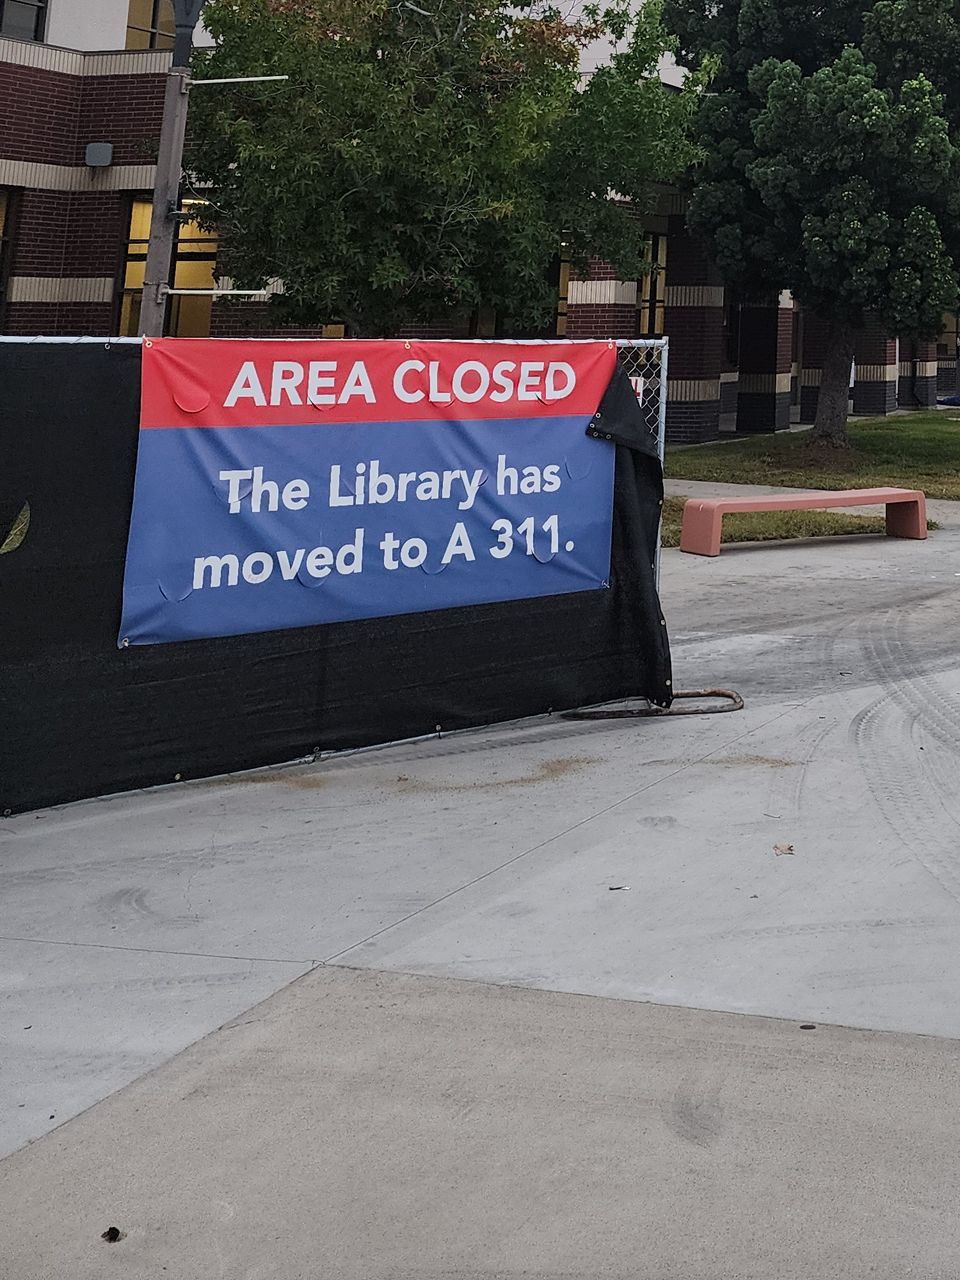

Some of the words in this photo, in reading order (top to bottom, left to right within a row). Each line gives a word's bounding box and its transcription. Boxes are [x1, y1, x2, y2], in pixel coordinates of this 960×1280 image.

[223, 360, 377, 408] AREA
[393, 359, 577, 404] CLOSED
[219, 465, 310, 514] The
[329, 460, 484, 511] Library
[496, 454, 562, 496] has
[192, 528, 364, 590] moved
[379, 532, 428, 571] to
[441, 522, 476, 565] A
[488, 514, 575, 559] 311.
